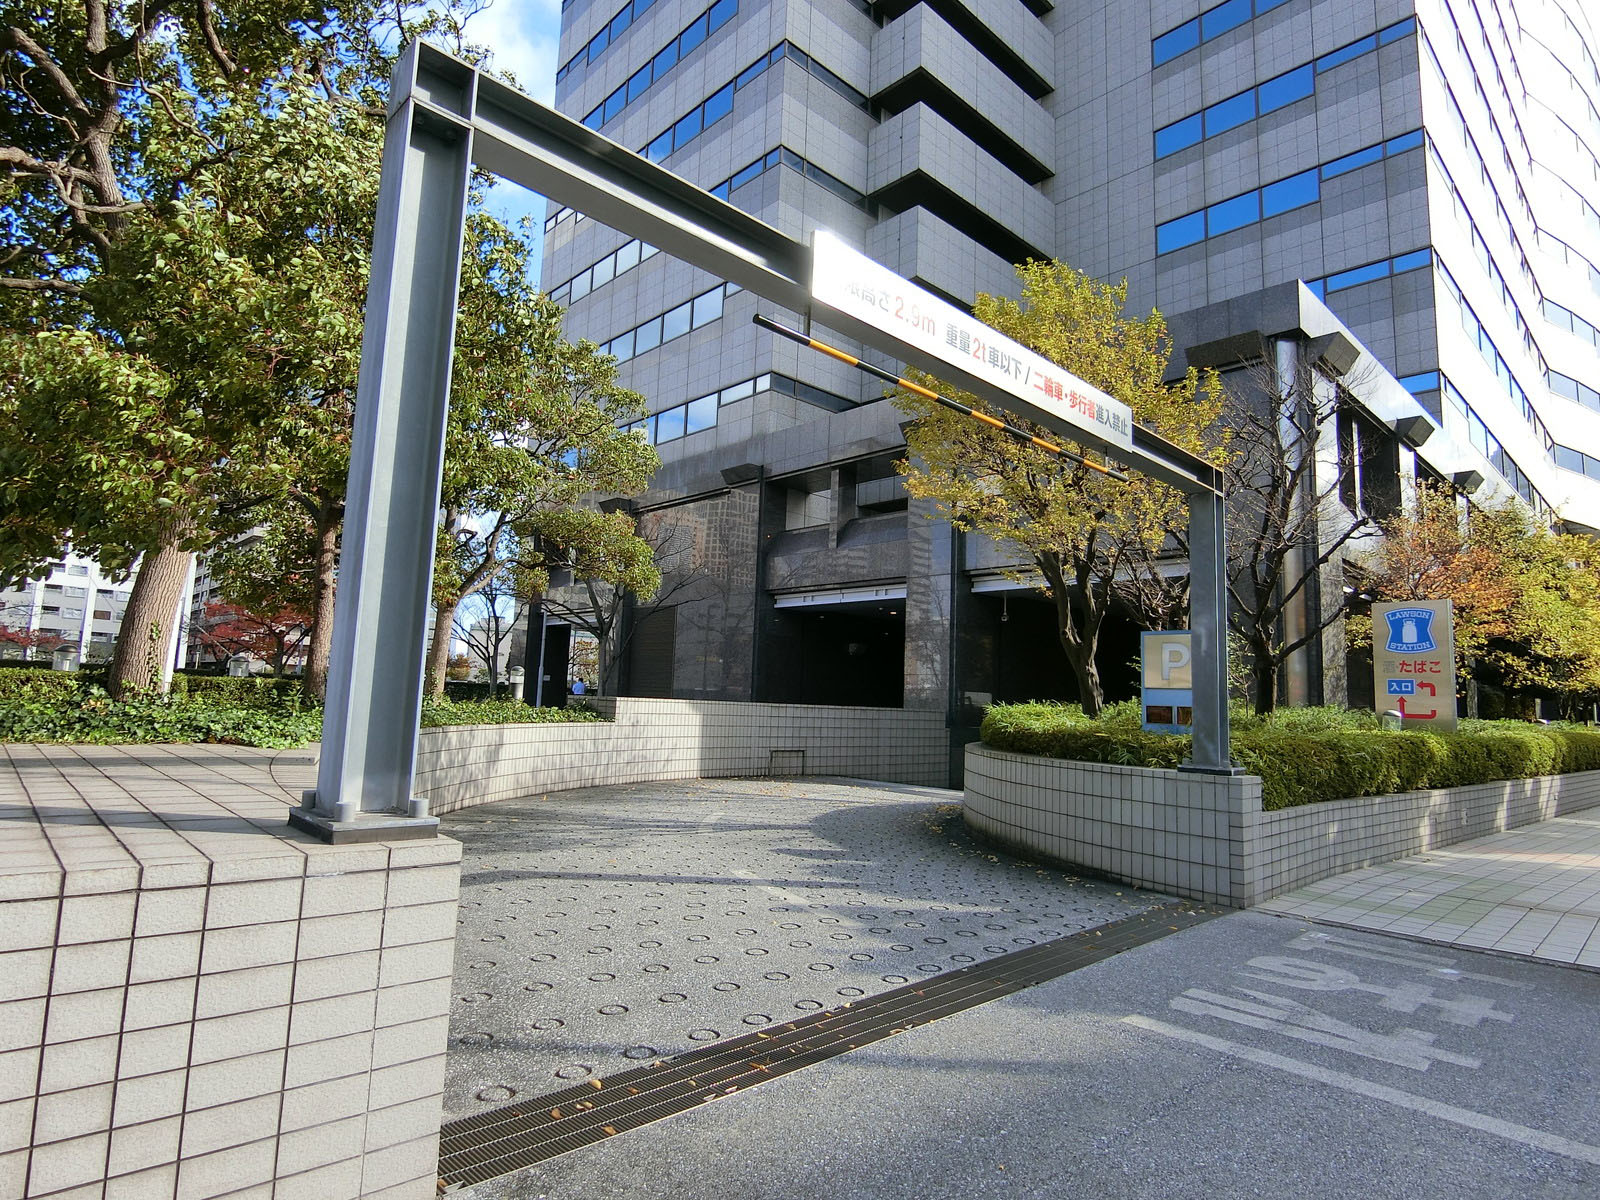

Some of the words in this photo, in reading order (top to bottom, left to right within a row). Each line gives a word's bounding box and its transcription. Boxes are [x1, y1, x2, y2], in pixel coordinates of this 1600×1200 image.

[1388, 610, 1430, 621] LAWSON
[1389, 641, 1431, 651] STATION
[1161, 642, 1190, 681] P
[1390, 682, 1412, 692] 入口
